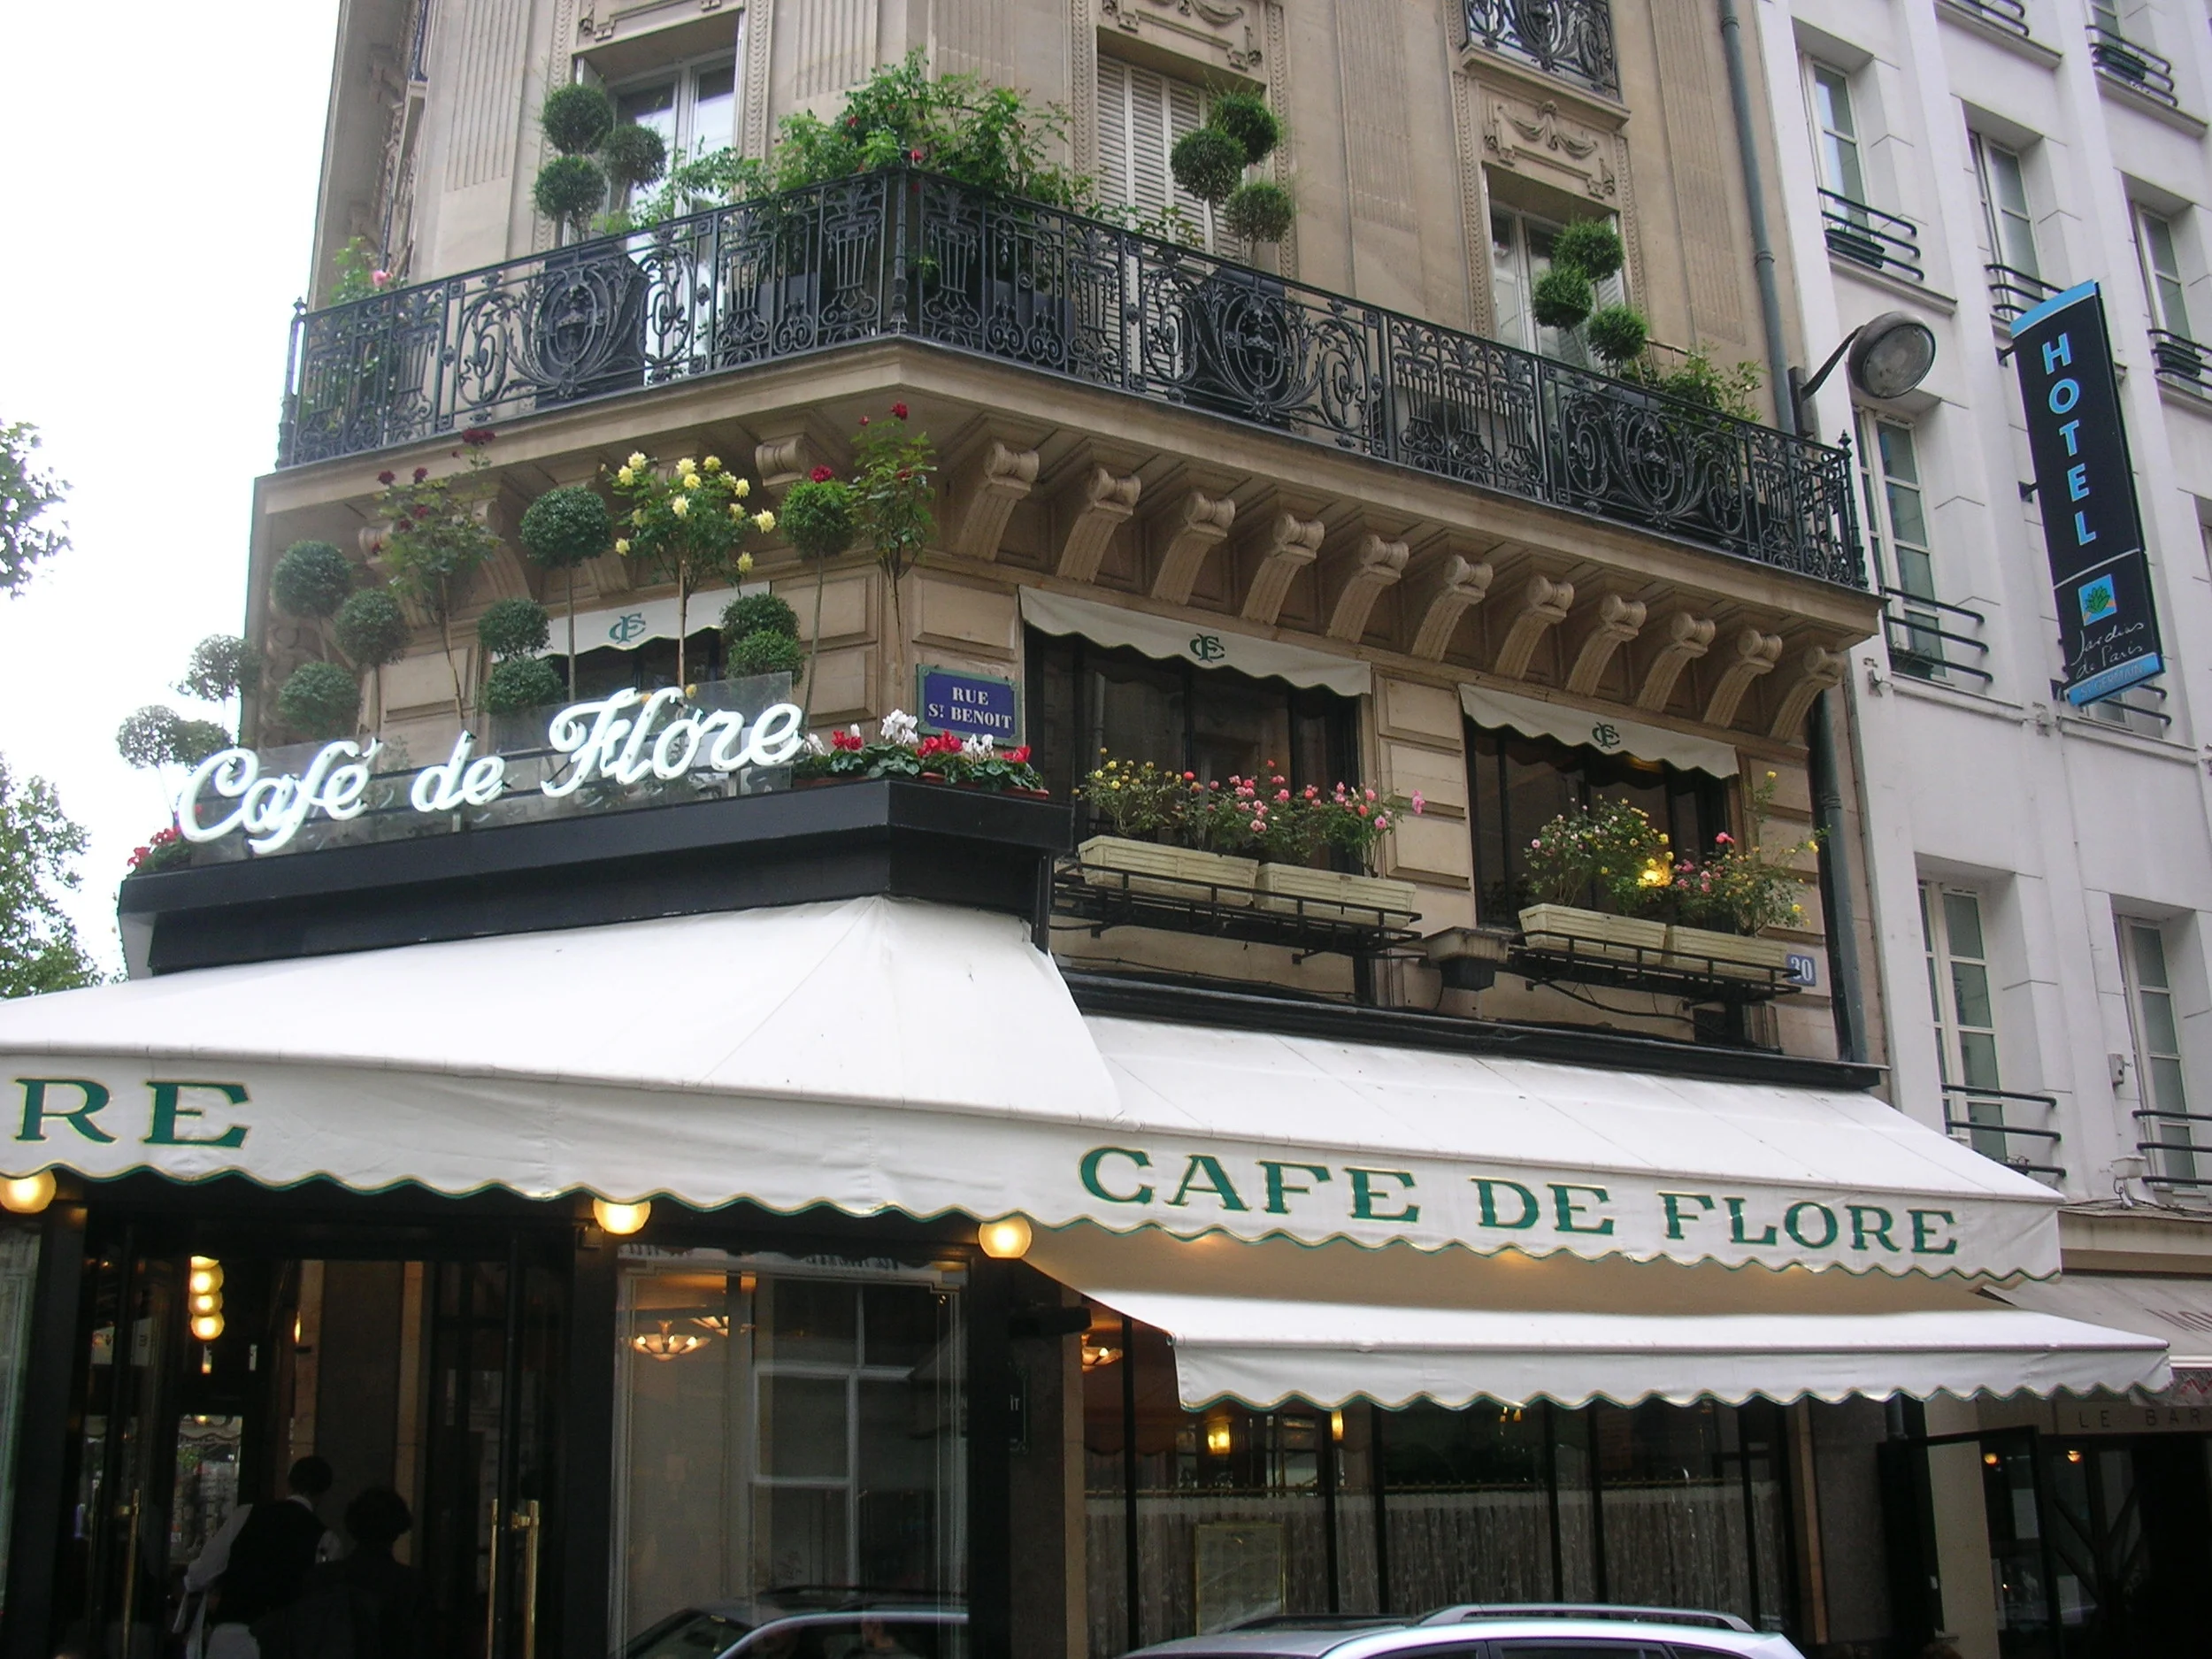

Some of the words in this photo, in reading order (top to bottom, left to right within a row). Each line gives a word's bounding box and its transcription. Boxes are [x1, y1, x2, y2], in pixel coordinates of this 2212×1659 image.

[2041, 332, 2096, 545] HOTEL
[2101, 641, 2142, 667] Paris
[950, 706, 1012, 729] BENOIT
[952, 687, 989, 705] RUE
[177, 736, 384, 855] Café
[411, 729, 511, 813] de
[541, 686, 806, 798] Flore
[12, 1076, 252, 1148] RE
[1078, 1146, 1421, 1225] CAFE
[1470, 1175, 1615, 1235] DE
[1656, 1190, 1958, 1256] FLORE
[2079, 1409, 2111, 1428] LE
